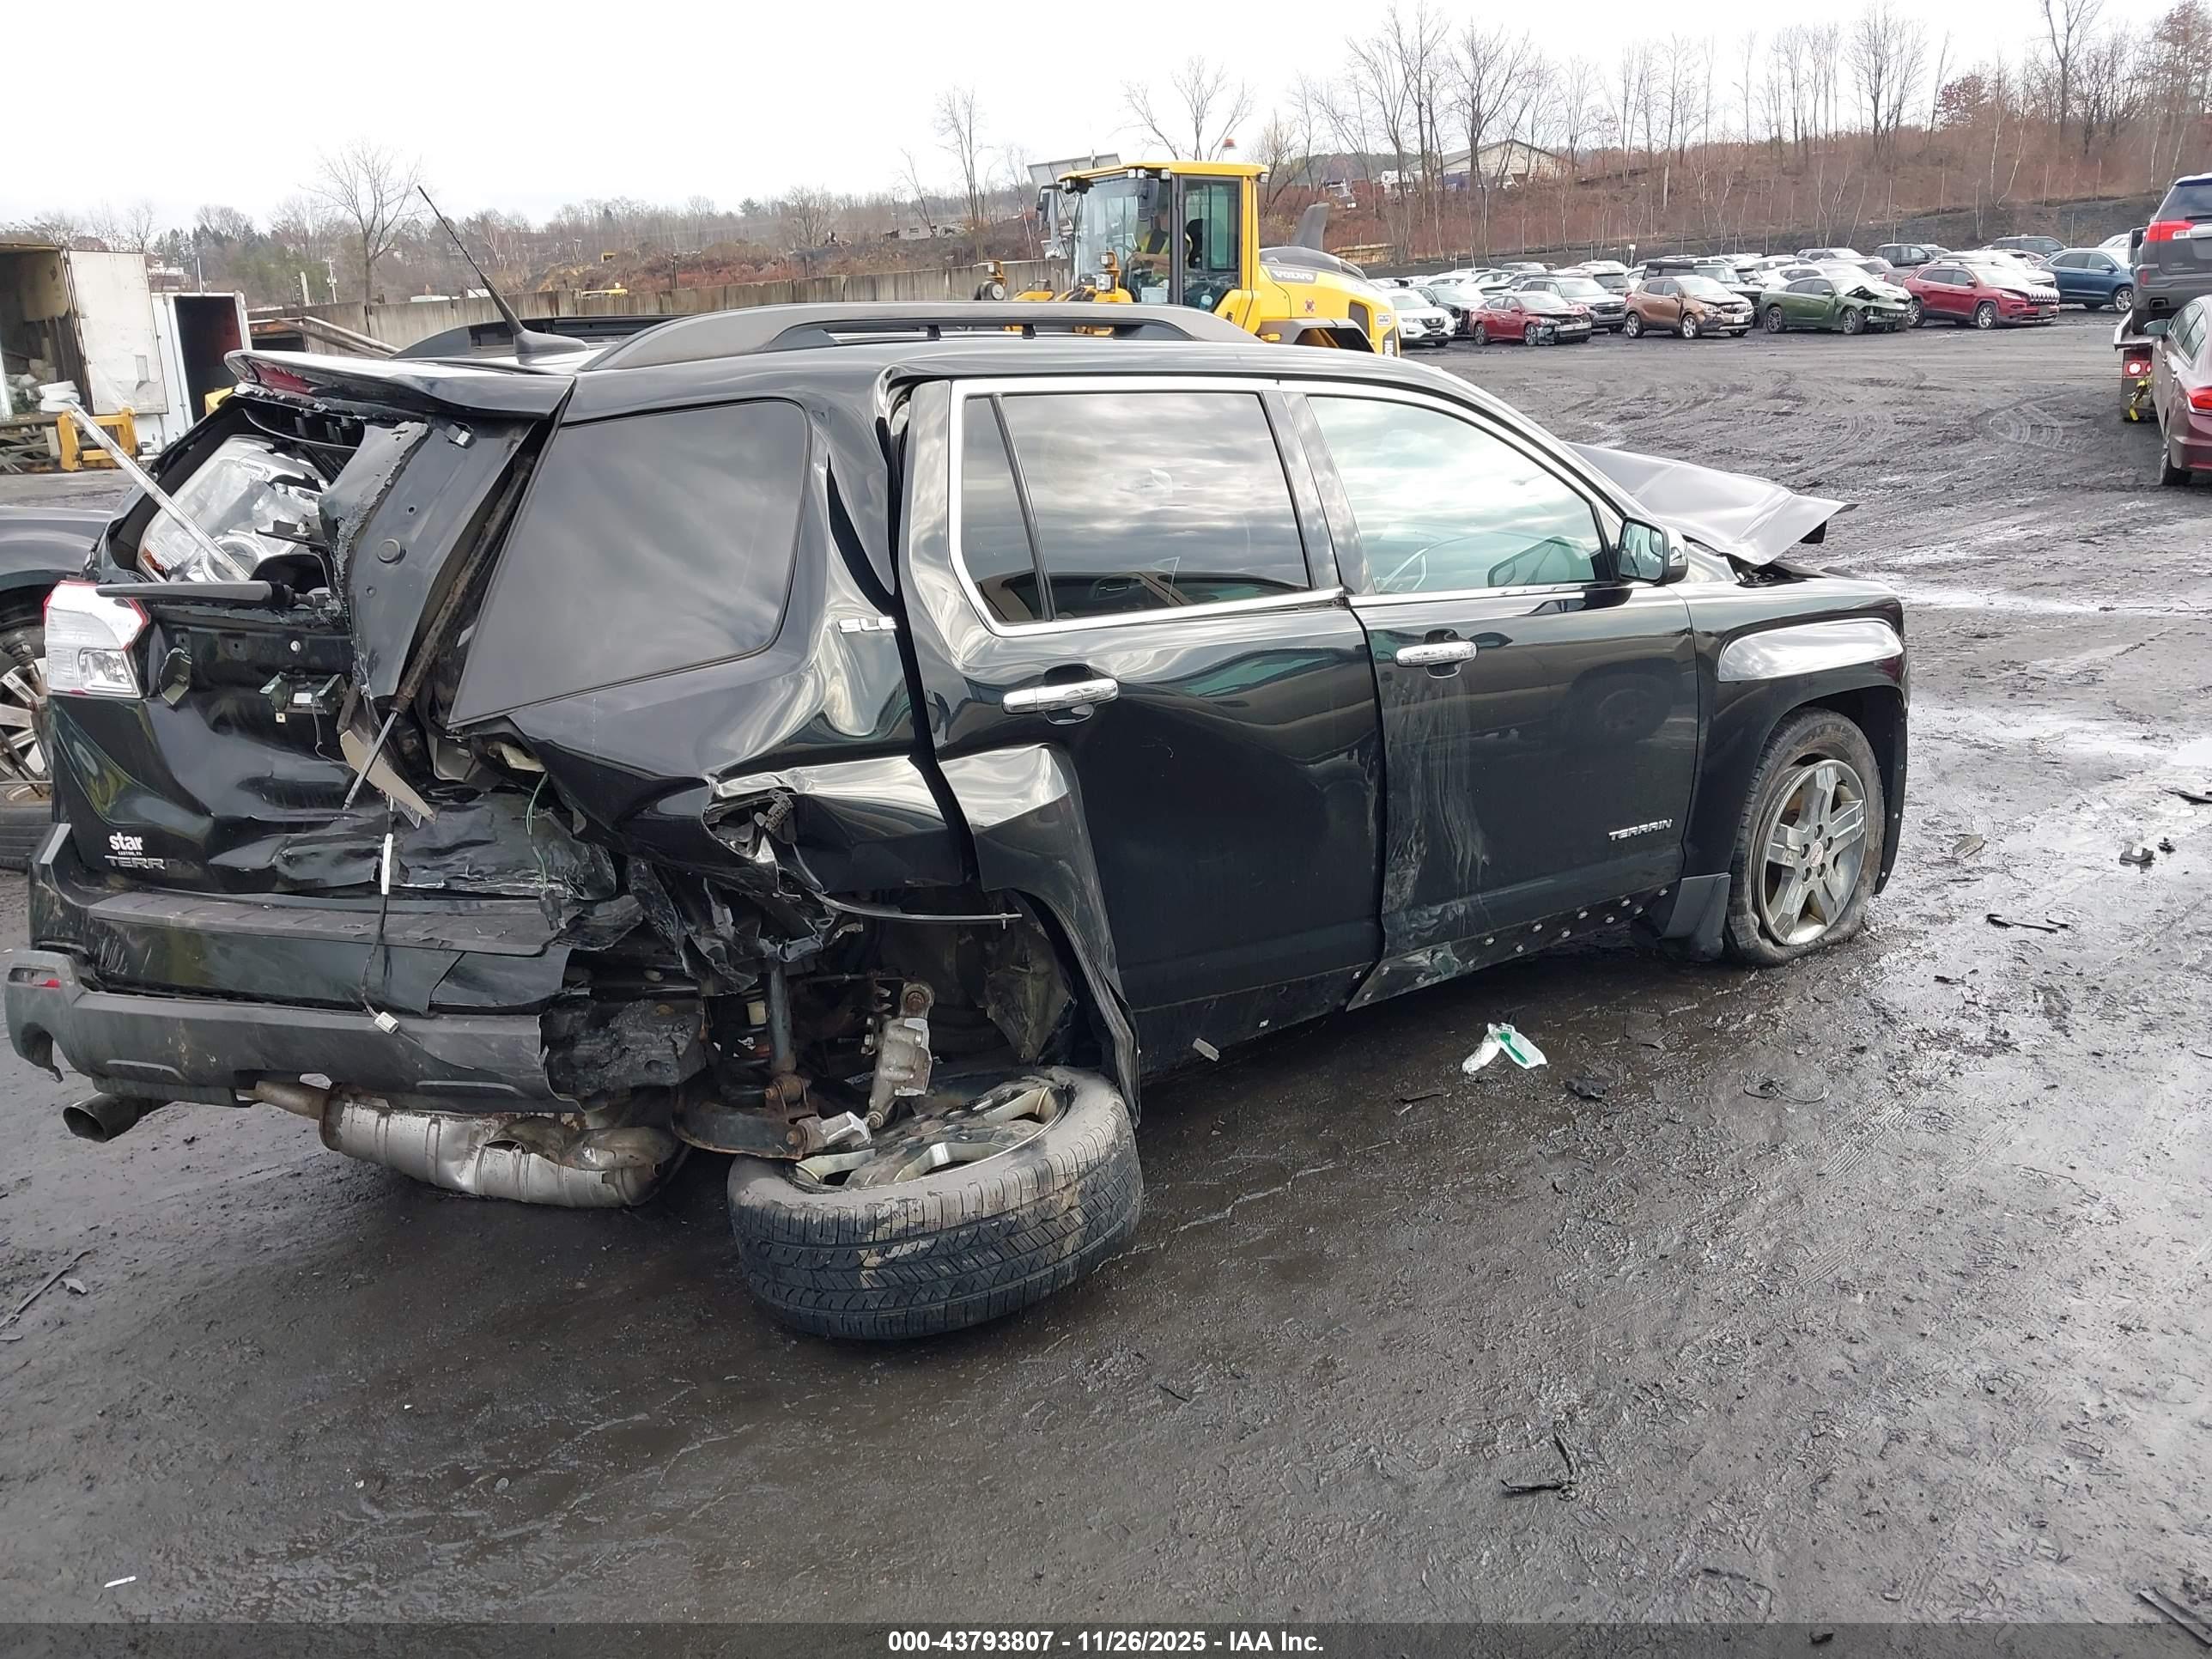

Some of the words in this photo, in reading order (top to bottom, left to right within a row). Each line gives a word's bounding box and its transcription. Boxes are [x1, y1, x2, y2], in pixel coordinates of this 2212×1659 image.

[1272, 270, 1314, 281] VOLVO
[1608, 818, 1672, 841] TERRAIN
[109, 832, 143, 851] star
